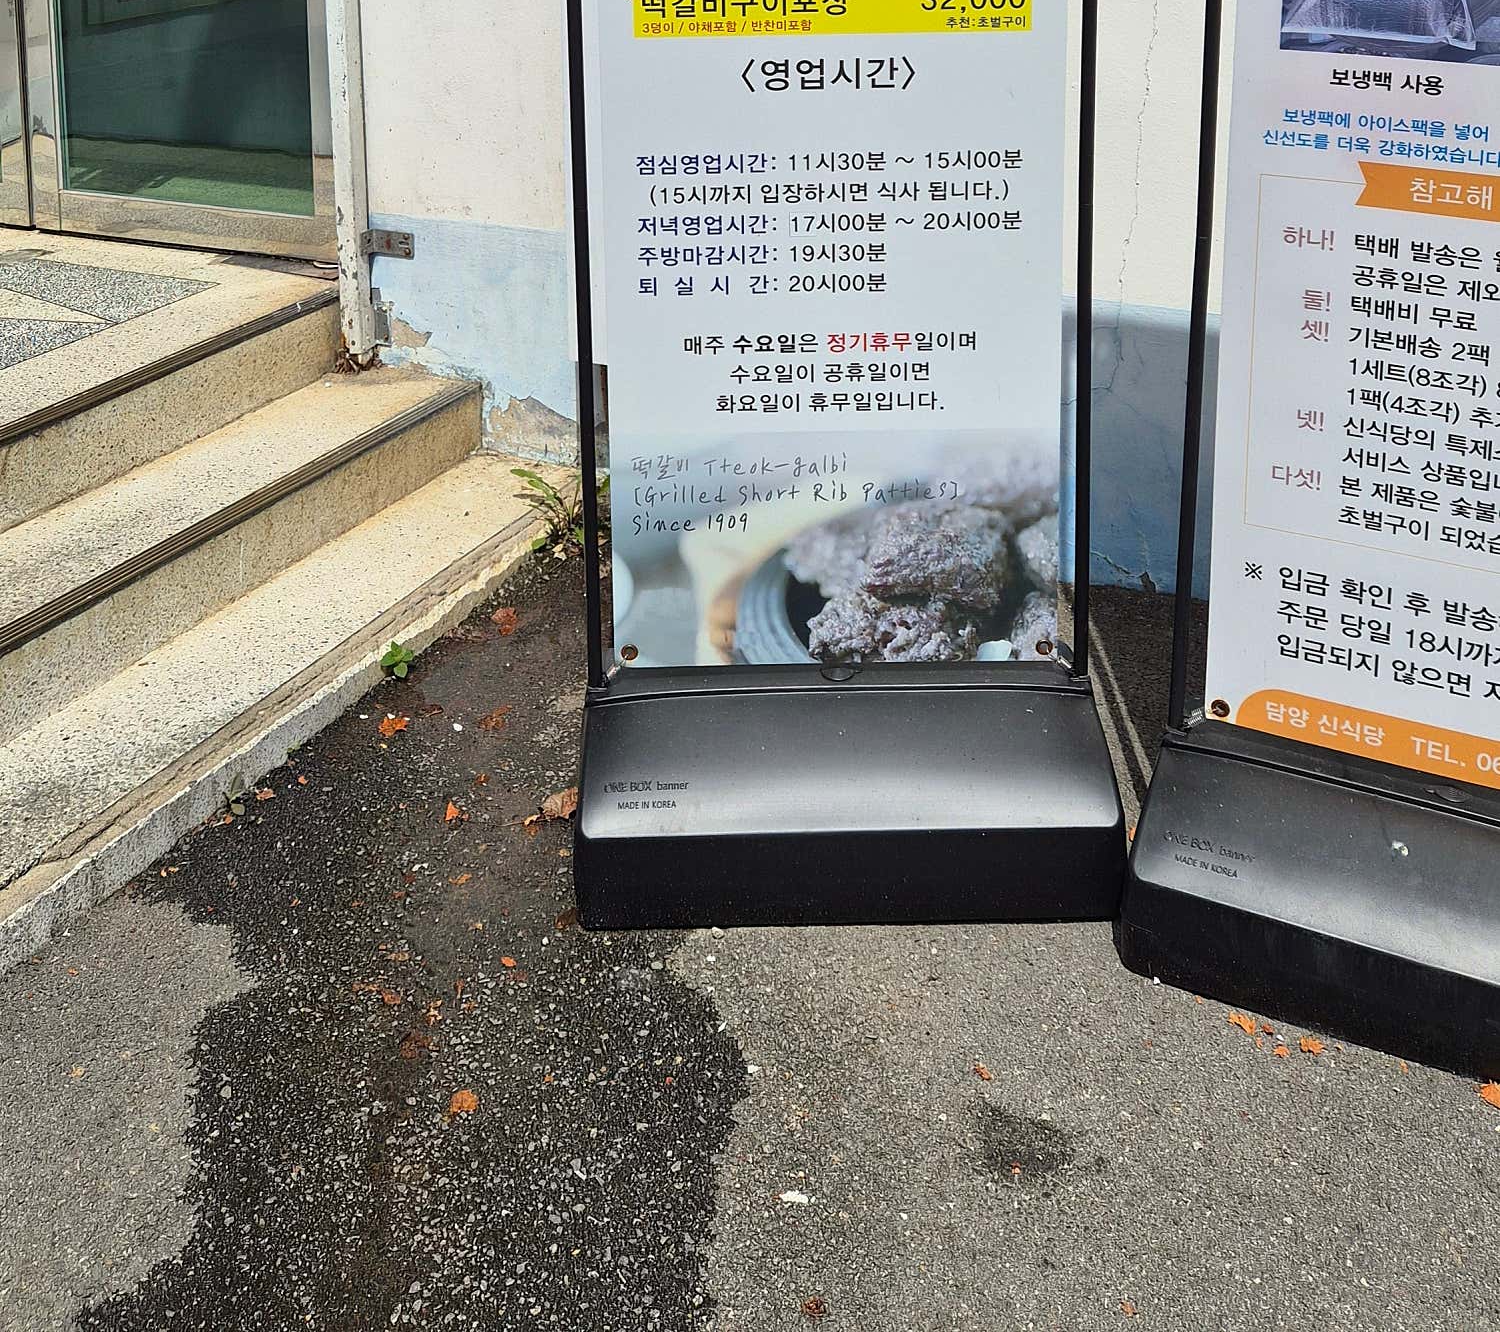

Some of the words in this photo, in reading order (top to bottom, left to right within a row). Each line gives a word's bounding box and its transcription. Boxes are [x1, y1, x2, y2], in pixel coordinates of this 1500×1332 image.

[643, 22, 673, 34] 3덩이
[689, 21, 736, 33] 야채포함
[752, 20, 812, 31] 반찬미포함
[1330, 69, 1392, 91] 보냉백
[1401, 75, 1444, 95] 사용
[1283, 109, 1350, 128] 보냉팩에
[1359, 115, 1446, 137] 아이스팩을
[1455, 124, 1488, 142] 넣어
[1263, 130, 1330, 149] 신선도를
[1338, 137, 1371, 153] 더욱
[637, 154, 775, 175] 점심영업시간:
[789, 152, 886, 172] 11시30분
[925, 150, 1022, 169] 15시00분
[651, 185, 750, 206] (15시까지
[761, 182, 867, 203] 입장하시면
[878, 182, 920, 201] 식사
[928, 180, 1008, 200] 됩니다.)
[1410, 178, 1492, 210] 참고해
[638, 215, 776, 236] 저녁영업시간:
[792, 213, 886, 232] 17시00분
[924, 211, 1022, 230] 20시00분
[638, 245, 777, 266] 주방마감시간:
[790, 243, 886, 263] 19시30분
[1283, 227, 1334, 251] 하나!
[1355, 235, 1399, 259] 택배
[1411, 241, 1482, 269] 발송은
[1352, 265, 1448, 296] 공휴일은
[1351, 296, 1418, 324] 택배비
[1429, 307, 1477, 331] 무료
[684, 336, 724, 355] 매주
[733, 334, 818, 354] 수요일은
[828, 332, 975, 352] 정기휴무일이며
[1349, 328, 1442, 358] 기본배송
[1452, 343, 1489, 366] 2팩
[730, 364, 814, 384] 수요일이
[824, 362, 929, 382] 공휴일이면
[1349, 357, 1487, 398] 1세트(8조각)
[716, 394, 799, 413] 화요일이
[809, 391, 943, 411] 휴무일입니다.
[1346, 388, 1460, 427] 1팩(4조각)
[1344, 417, 1434, 450] 신식당의
[1342, 448, 1410, 474] 서비스
[739, 482, 800, 504] Short
[813, 482, 847, 502] Rib
[1272, 466, 1320, 490] 다섯!
[1339, 476, 1362, 497] 본
[1371, 483, 1440, 512] 제품은
[633, 513, 695, 534] Since
[707, 511, 748, 534] 1909
[1338, 506, 1430, 542] 초벌구이
[1280, 567, 1329, 596] 입금
[1340, 579, 1392, 610] 확인
[1404, 592, 1430, 616] 후
[1277, 601, 1328, 630] 주문
[1341, 614, 1390, 645] 당일
[1276, 634, 1380, 677] 입금되지
[1392, 660, 1470, 697] 않으면
[1265, 702, 1309, 727] 담양
[1318, 716, 1386, 747] 신식당
[1410, 736, 1466, 767] TEL.
[618, 802, 639, 810] MADE
[642, 801, 649, 809] IN
[652, 801, 676, 809] KOREA
